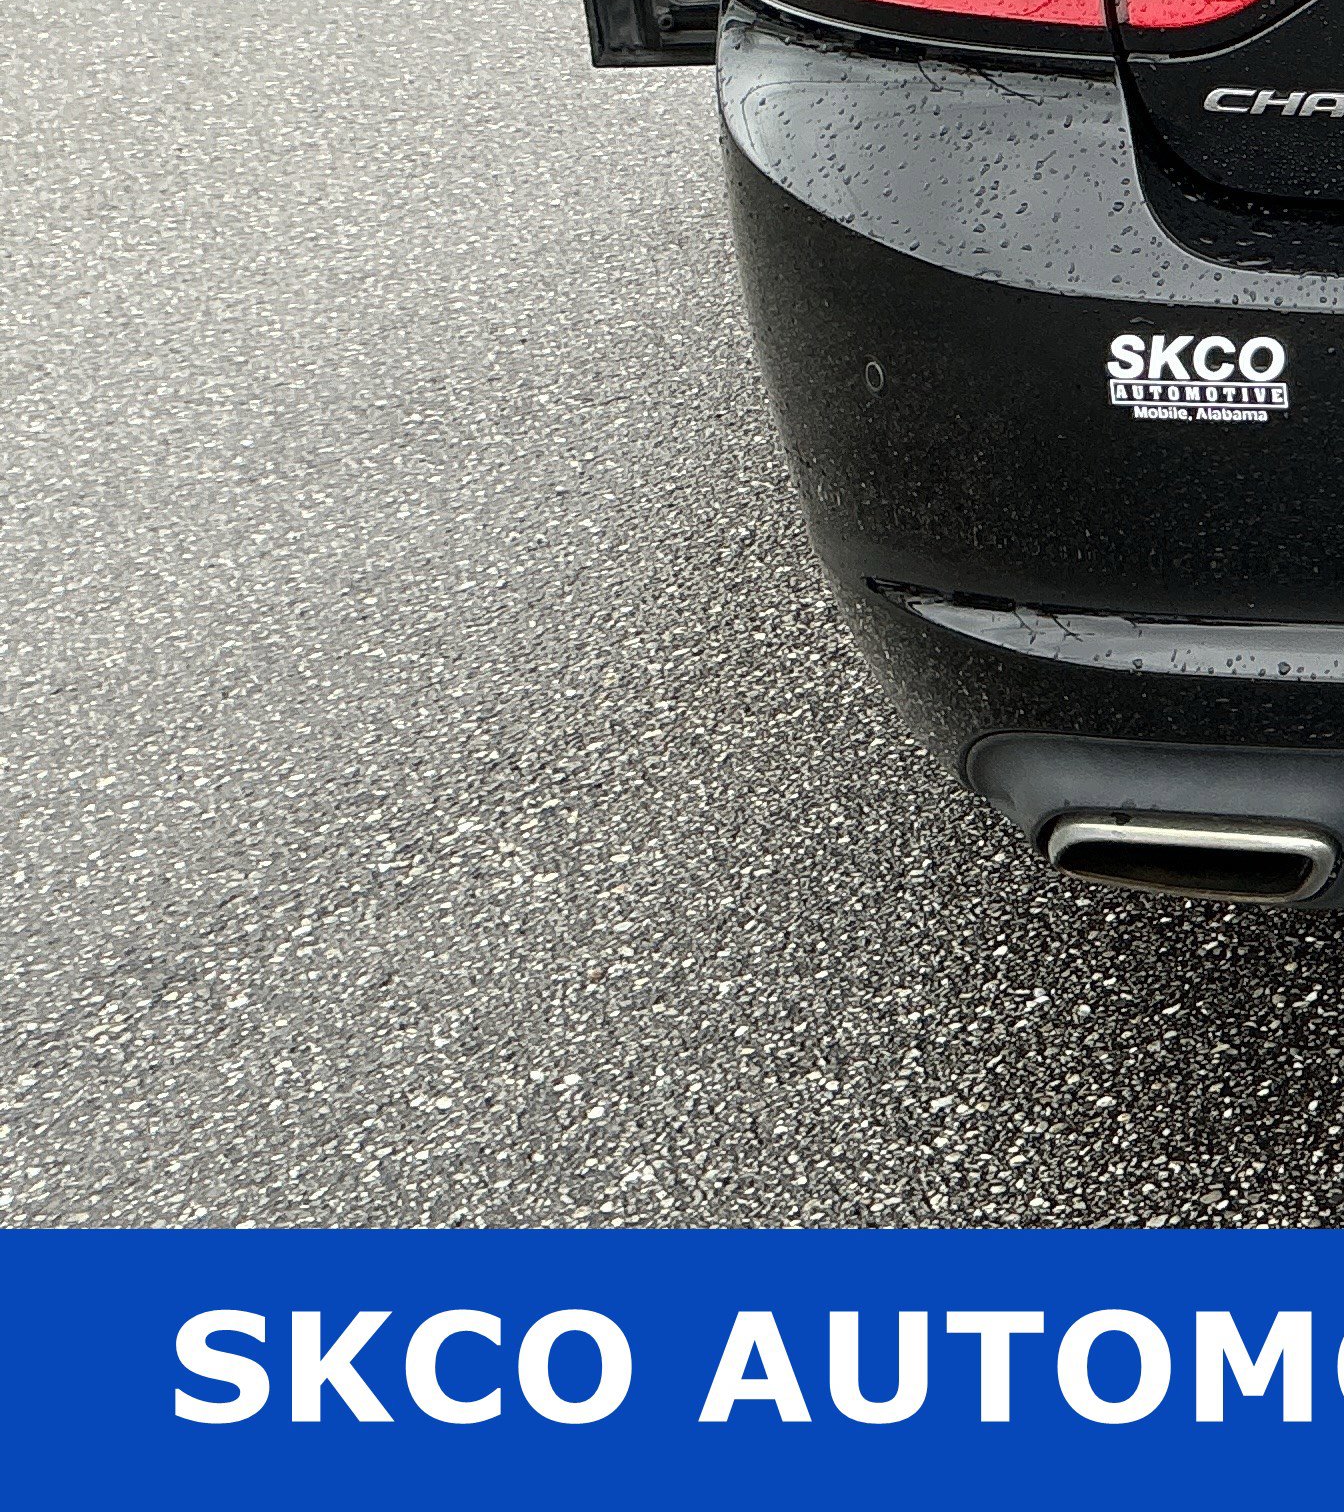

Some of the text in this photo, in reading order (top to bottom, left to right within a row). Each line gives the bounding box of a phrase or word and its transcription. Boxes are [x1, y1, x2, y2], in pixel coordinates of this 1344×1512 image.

[1107, 334, 1285, 382] SKCO
[1116, 384, 1284, 403] AUTOMOTIVE
[1133, 405, 1268, 422] Mobile, Alabama
